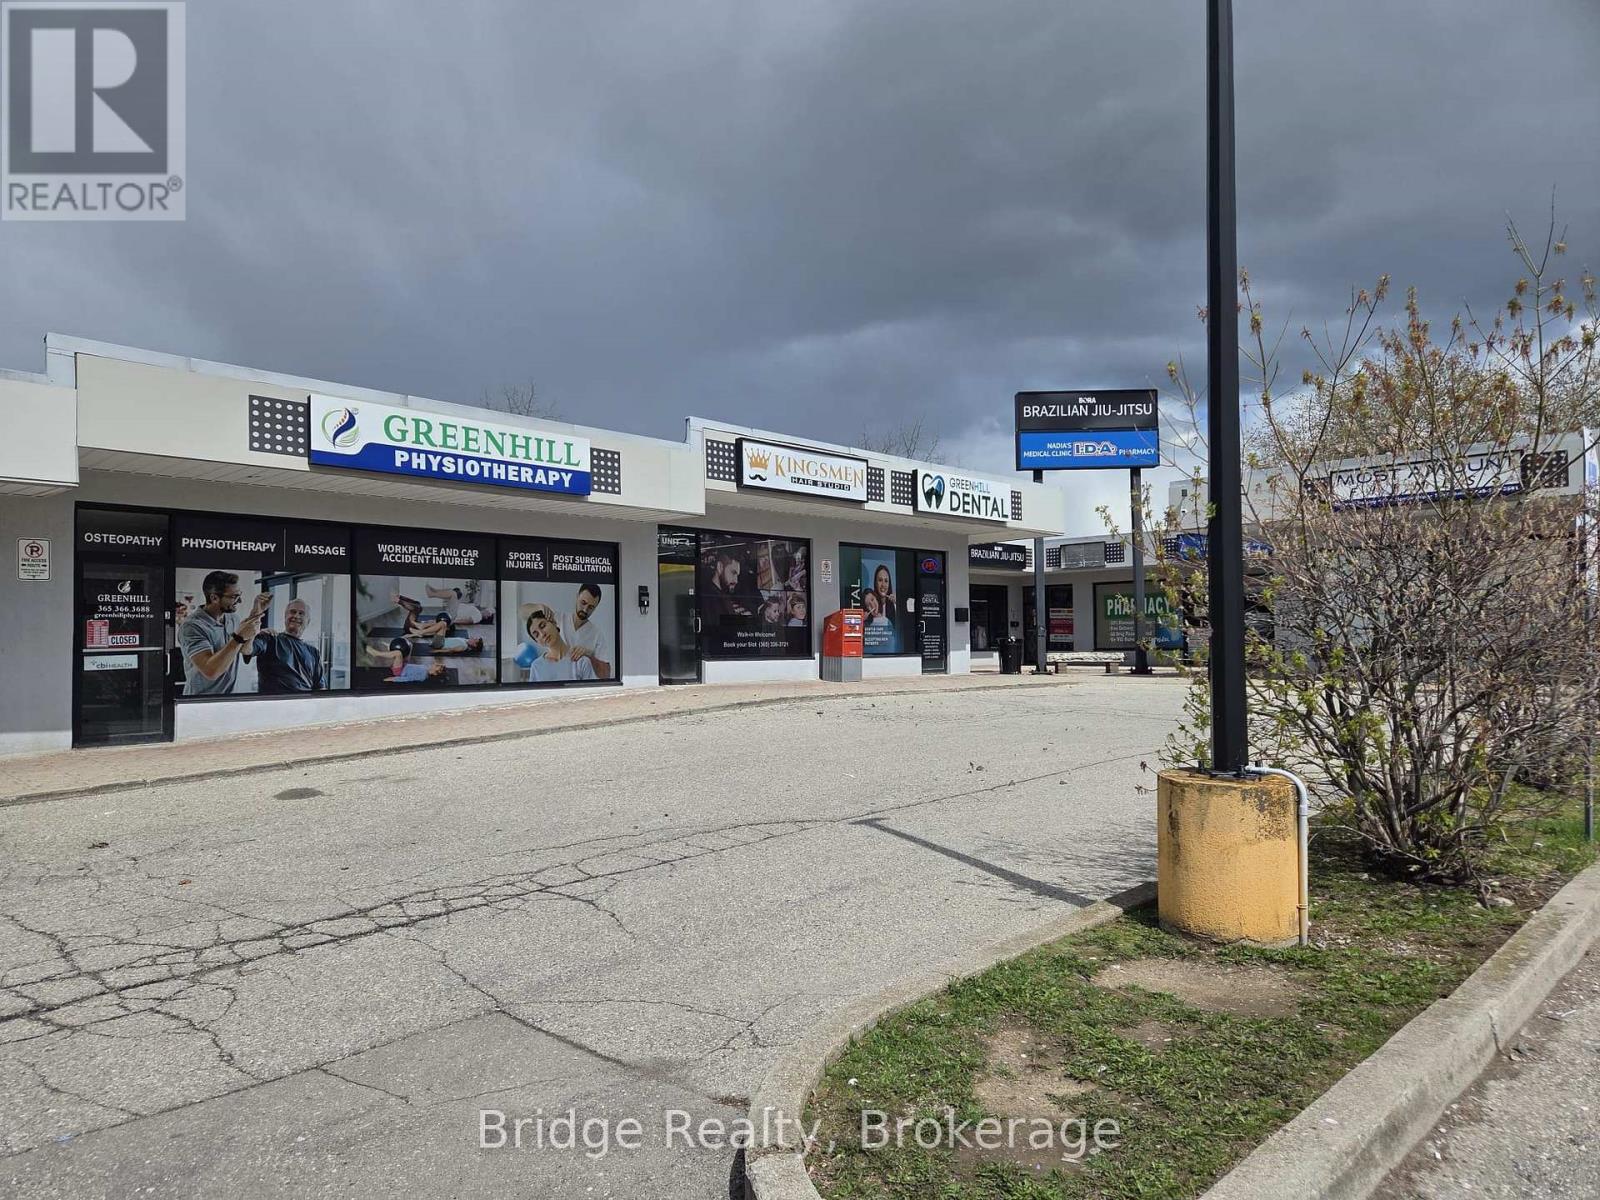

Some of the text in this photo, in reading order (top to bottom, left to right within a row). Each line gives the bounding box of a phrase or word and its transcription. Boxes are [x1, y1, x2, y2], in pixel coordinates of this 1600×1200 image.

[1023, 403, 1153, 418] BRAZILIAN JIU-JITSU
[383, 414, 581, 467] GREENHILL
[1024, 450, 1051, 458] MEDICAL
[394, 449, 573, 488] PHYSIOTHERAPY
[774, 454, 864, 489] KINGSMEN
[792, 477, 850, 491] HAIR STUDIO
[950, 477, 991, 494] GREENHILL
[950, 490, 1009, 518] DENTAL
[84, 532, 163, 547] OSTEOPATHY
[181, 537, 277, 553] PHYSIOTHERAPY
[294, 544, 346, 556] MASSAGE
[378, 543, 479, 558] WORKPLACE AND CAR
[508, 551, 541, 562] SPORTS
[970, 549, 1025, 562] BRAZILIAN JIU-JITSU
[382, 553, 475, 566] ACCIDENT INJURIES
[506, 560, 544, 570] INJURIES
[553, 554, 611, 566] POST SURGICAL
[552, 562, 613, 573] REHABILITATION
[97, 594, 151, 603] GREENHILL
[1106, 596, 1170, 616] PHARACY
[110, 636, 137, 645] CLOSED
